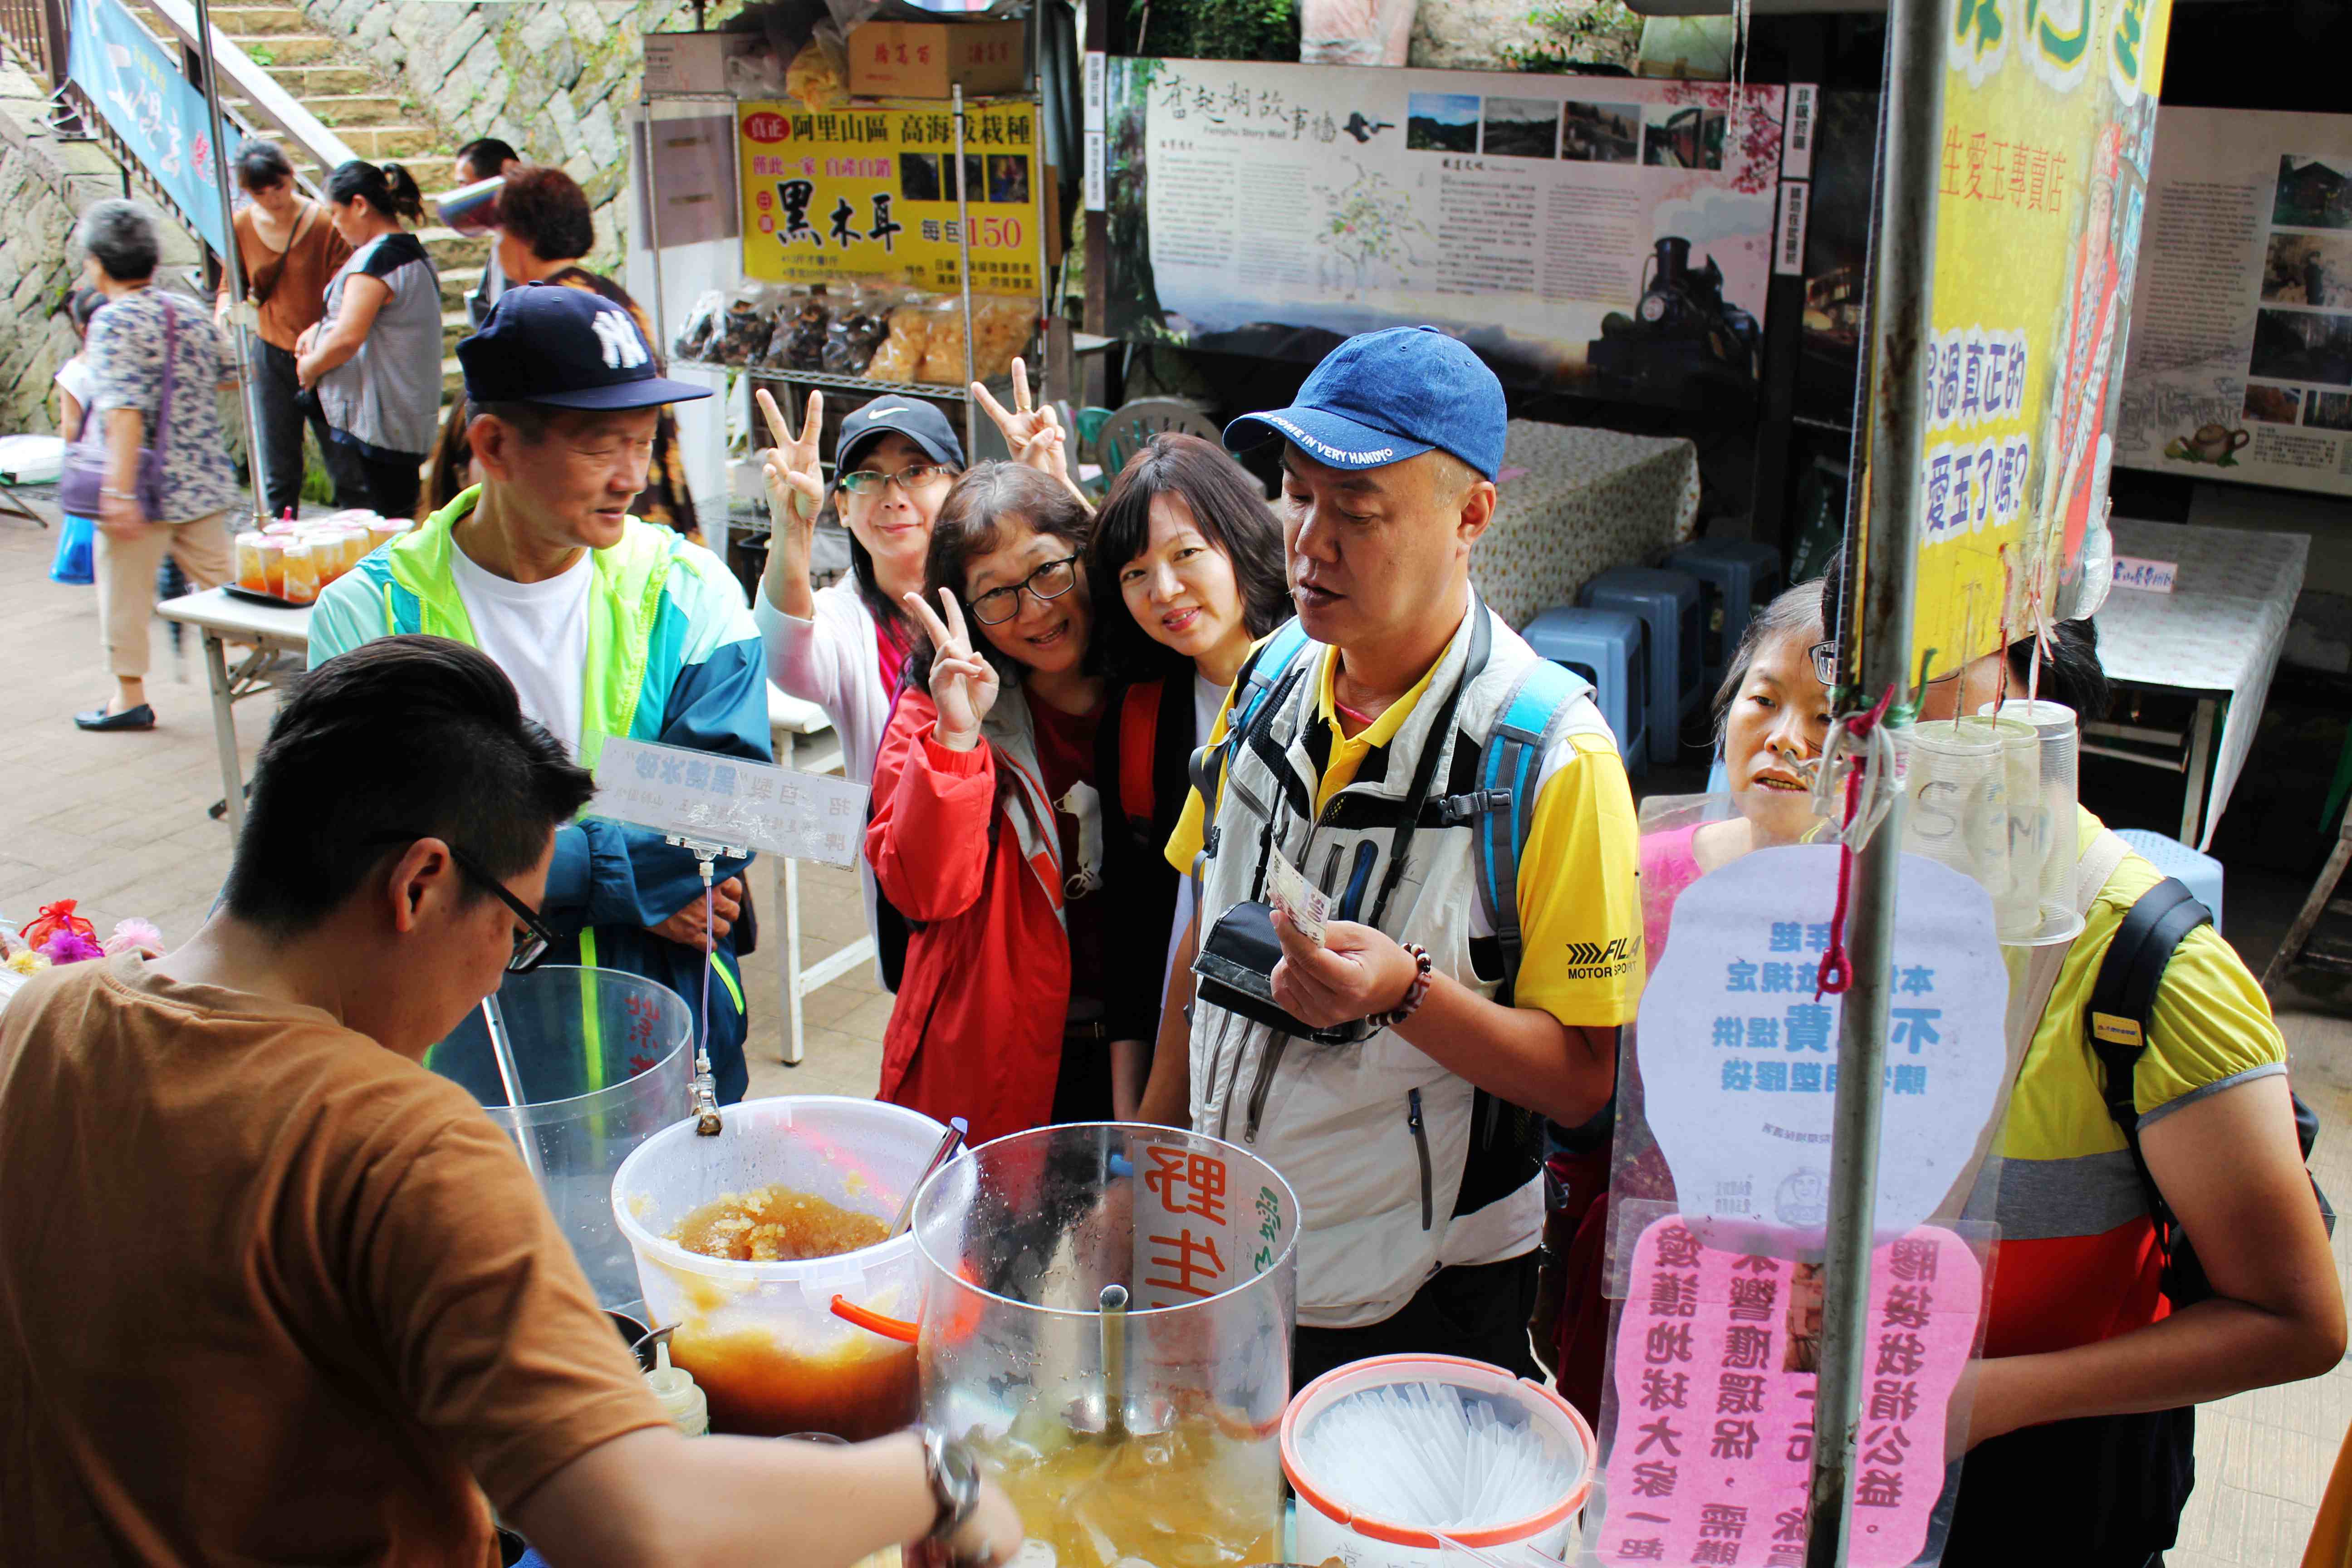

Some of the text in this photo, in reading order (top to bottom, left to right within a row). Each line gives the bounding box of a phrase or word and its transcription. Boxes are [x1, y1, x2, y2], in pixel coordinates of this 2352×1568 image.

[751, 118, 783, 137] 真正
[792, 114, 888, 143] 阿里山區
[777, 180, 901, 252] 黑木耳
[968, 217, 1023, 248] 150
[590, 309, 648, 369] NY
[1272, 416, 1305, 439] COME
[1301, 434, 1318, 449] IN
[1316, 441, 1347, 463] VERY
[1921, 443, 2028, 533] 愛玉了嗎?
[1597, 935, 1642, 964] FILA
[1568, 961, 1637, 979] MOTOR SPORT
